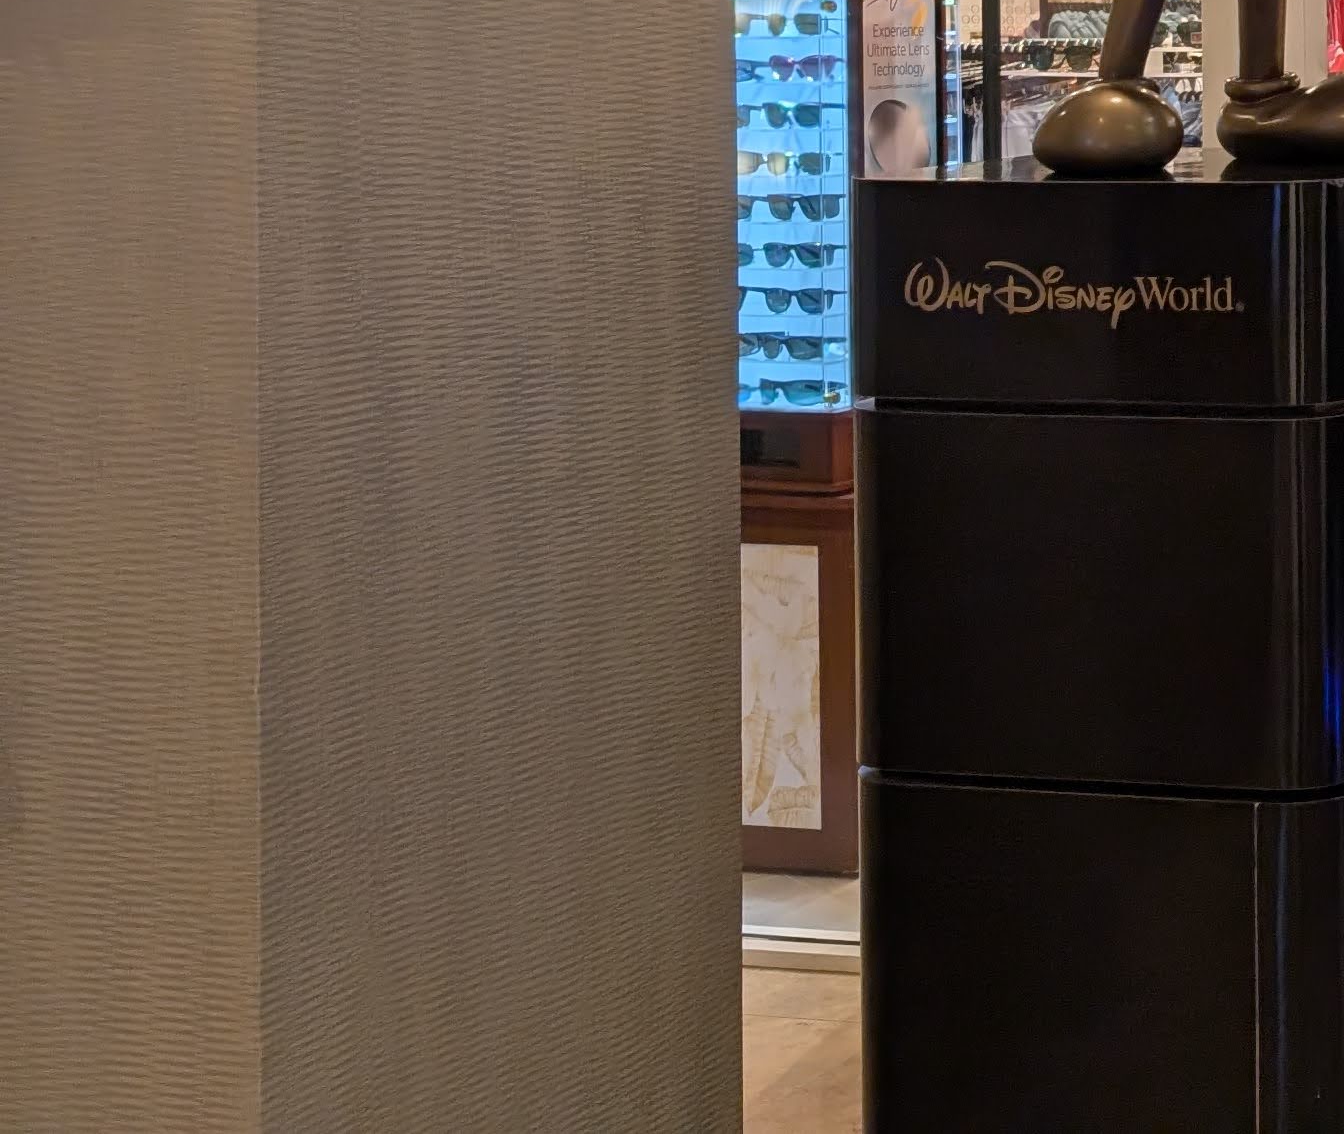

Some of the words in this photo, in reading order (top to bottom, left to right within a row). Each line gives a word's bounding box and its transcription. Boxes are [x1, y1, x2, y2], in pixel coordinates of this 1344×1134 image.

[872, 24, 925, 40] Experience
[866, 44, 906, 57] Ultimate
[908, 44, 930, 56] Lens
[872, 63, 925, 77] Technology
